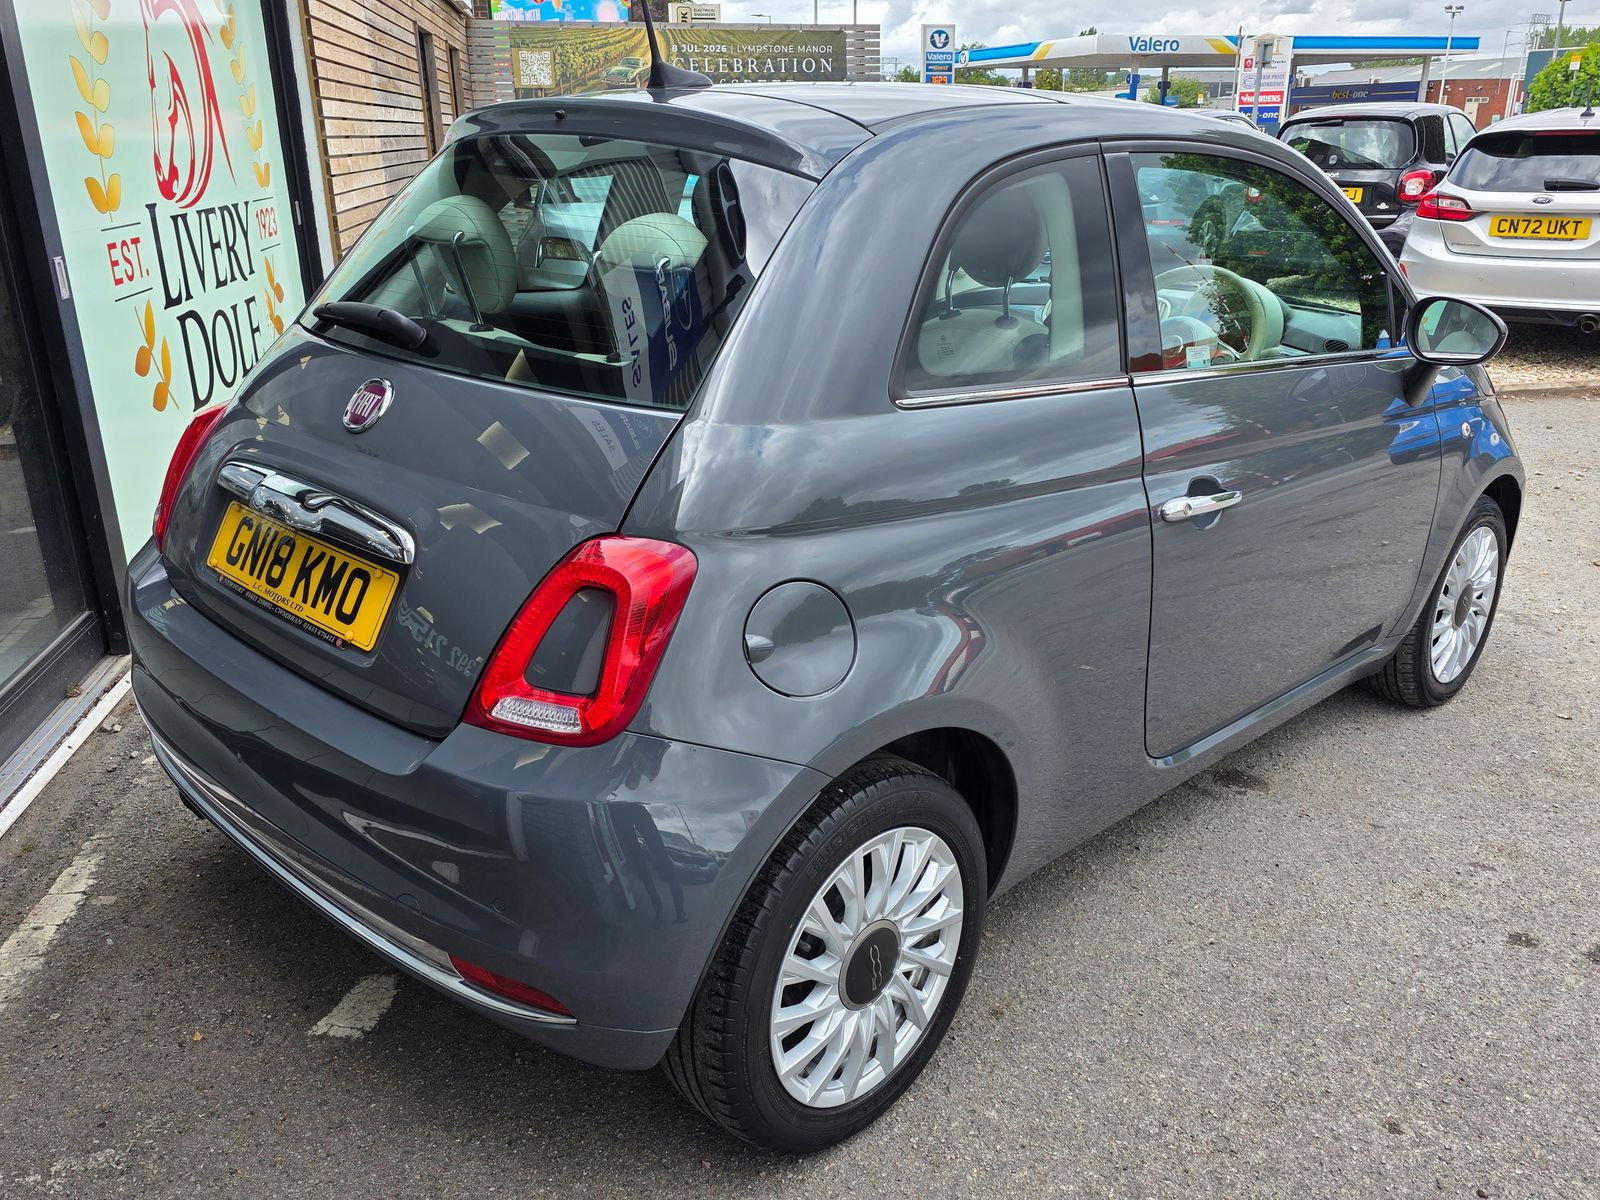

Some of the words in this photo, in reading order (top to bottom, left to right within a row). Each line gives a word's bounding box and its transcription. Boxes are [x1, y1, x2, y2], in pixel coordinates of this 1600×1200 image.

[737, 45, 794, 53] LYMPSTONE
[798, 45, 833, 53] MANOR
[1129, 36, 1179, 52] Valero
[672, 58, 833, 73] CELEBRATION
[255, 206, 279, 240] 1923
[1497, 218, 1543, 235] CN72
[1546, 220, 1583, 236] UKT
[106, 237, 150, 286] EST.
[145, 200, 255, 310] LIVERY
[176, 296, 262, 412] DOLE
[351, 390, 382, 418] FIAT
[225, 515, 296, 589] GN18
[290, 545, 371, 626] KMO
[263, 588, 291, 606] MOTORS
[290, 600, 304, 613] LTD
